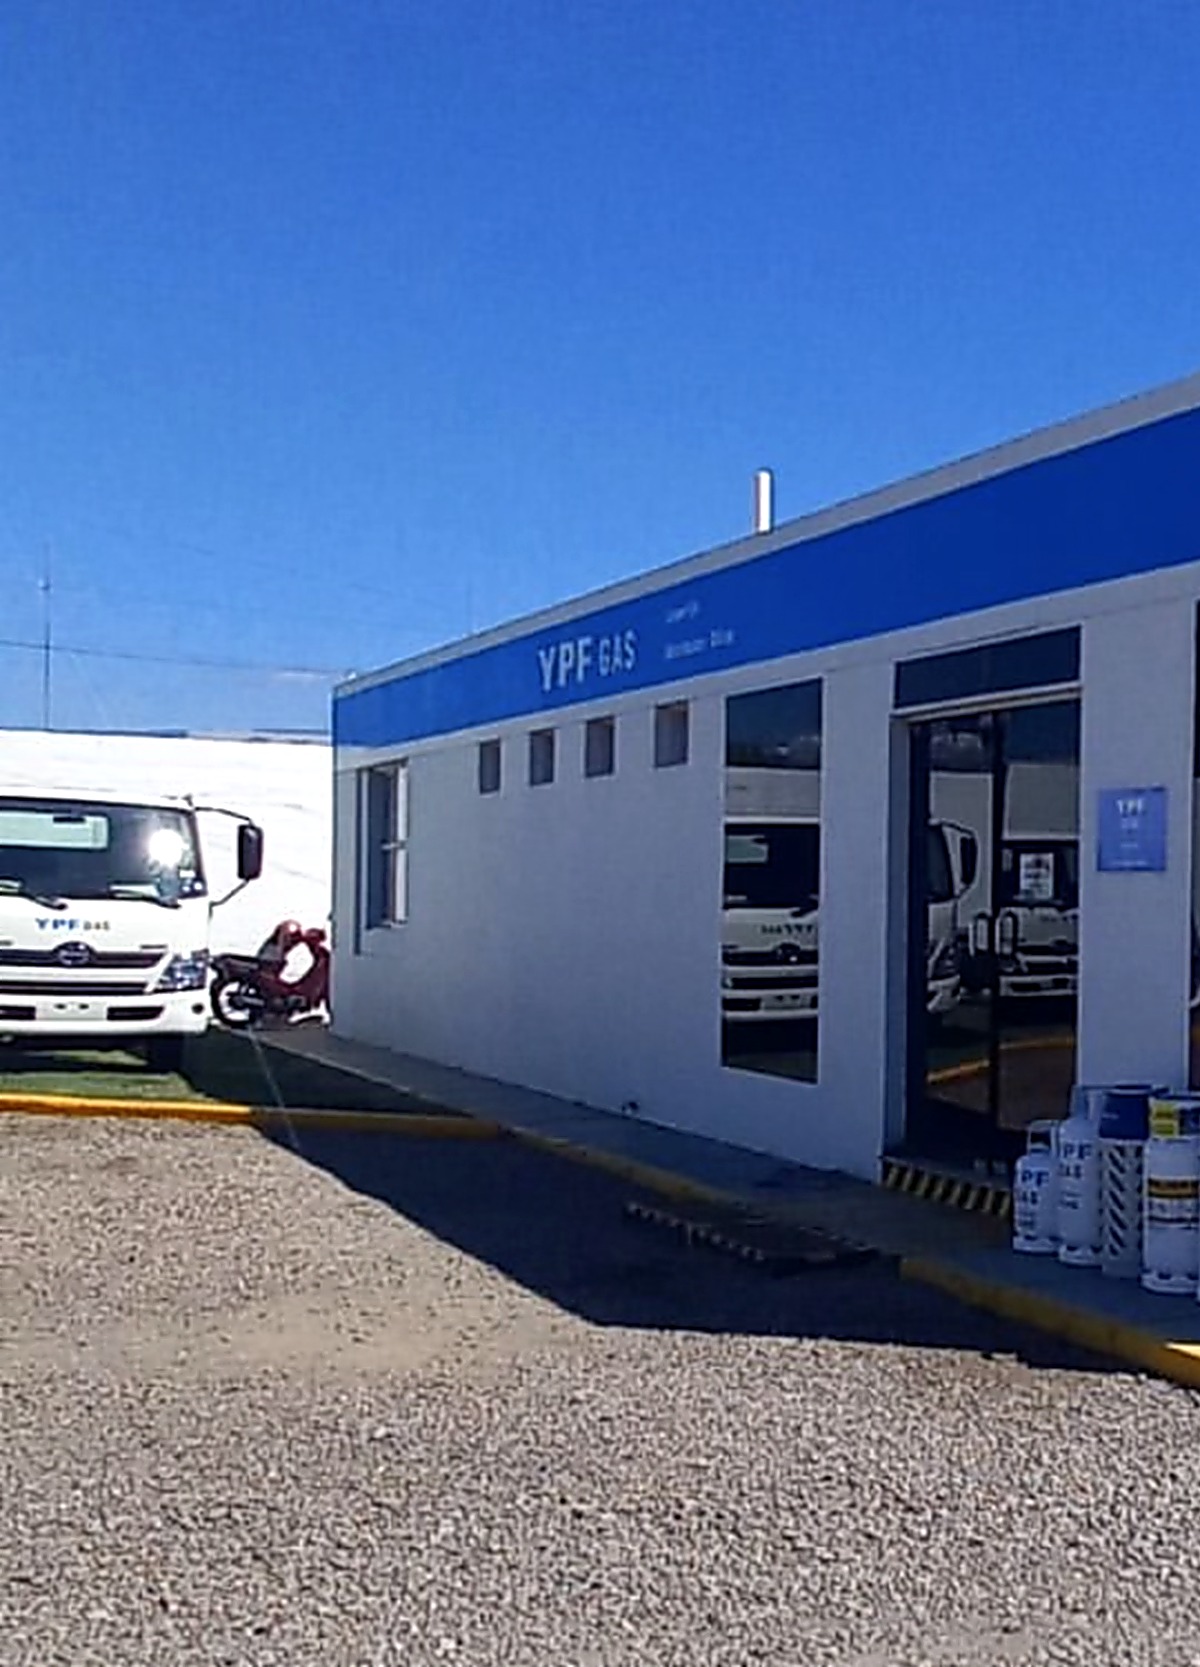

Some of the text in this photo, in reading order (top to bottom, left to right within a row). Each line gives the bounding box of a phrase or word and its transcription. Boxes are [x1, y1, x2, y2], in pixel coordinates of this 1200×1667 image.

[537, 636, 593, 692] YPF
[600, 628, 638, 677] GAS
[35, 918, 80, 930] YPF
[1063, 1144, 1093, 1160] PF
[1021, 1169, 1050, 1187] PF
